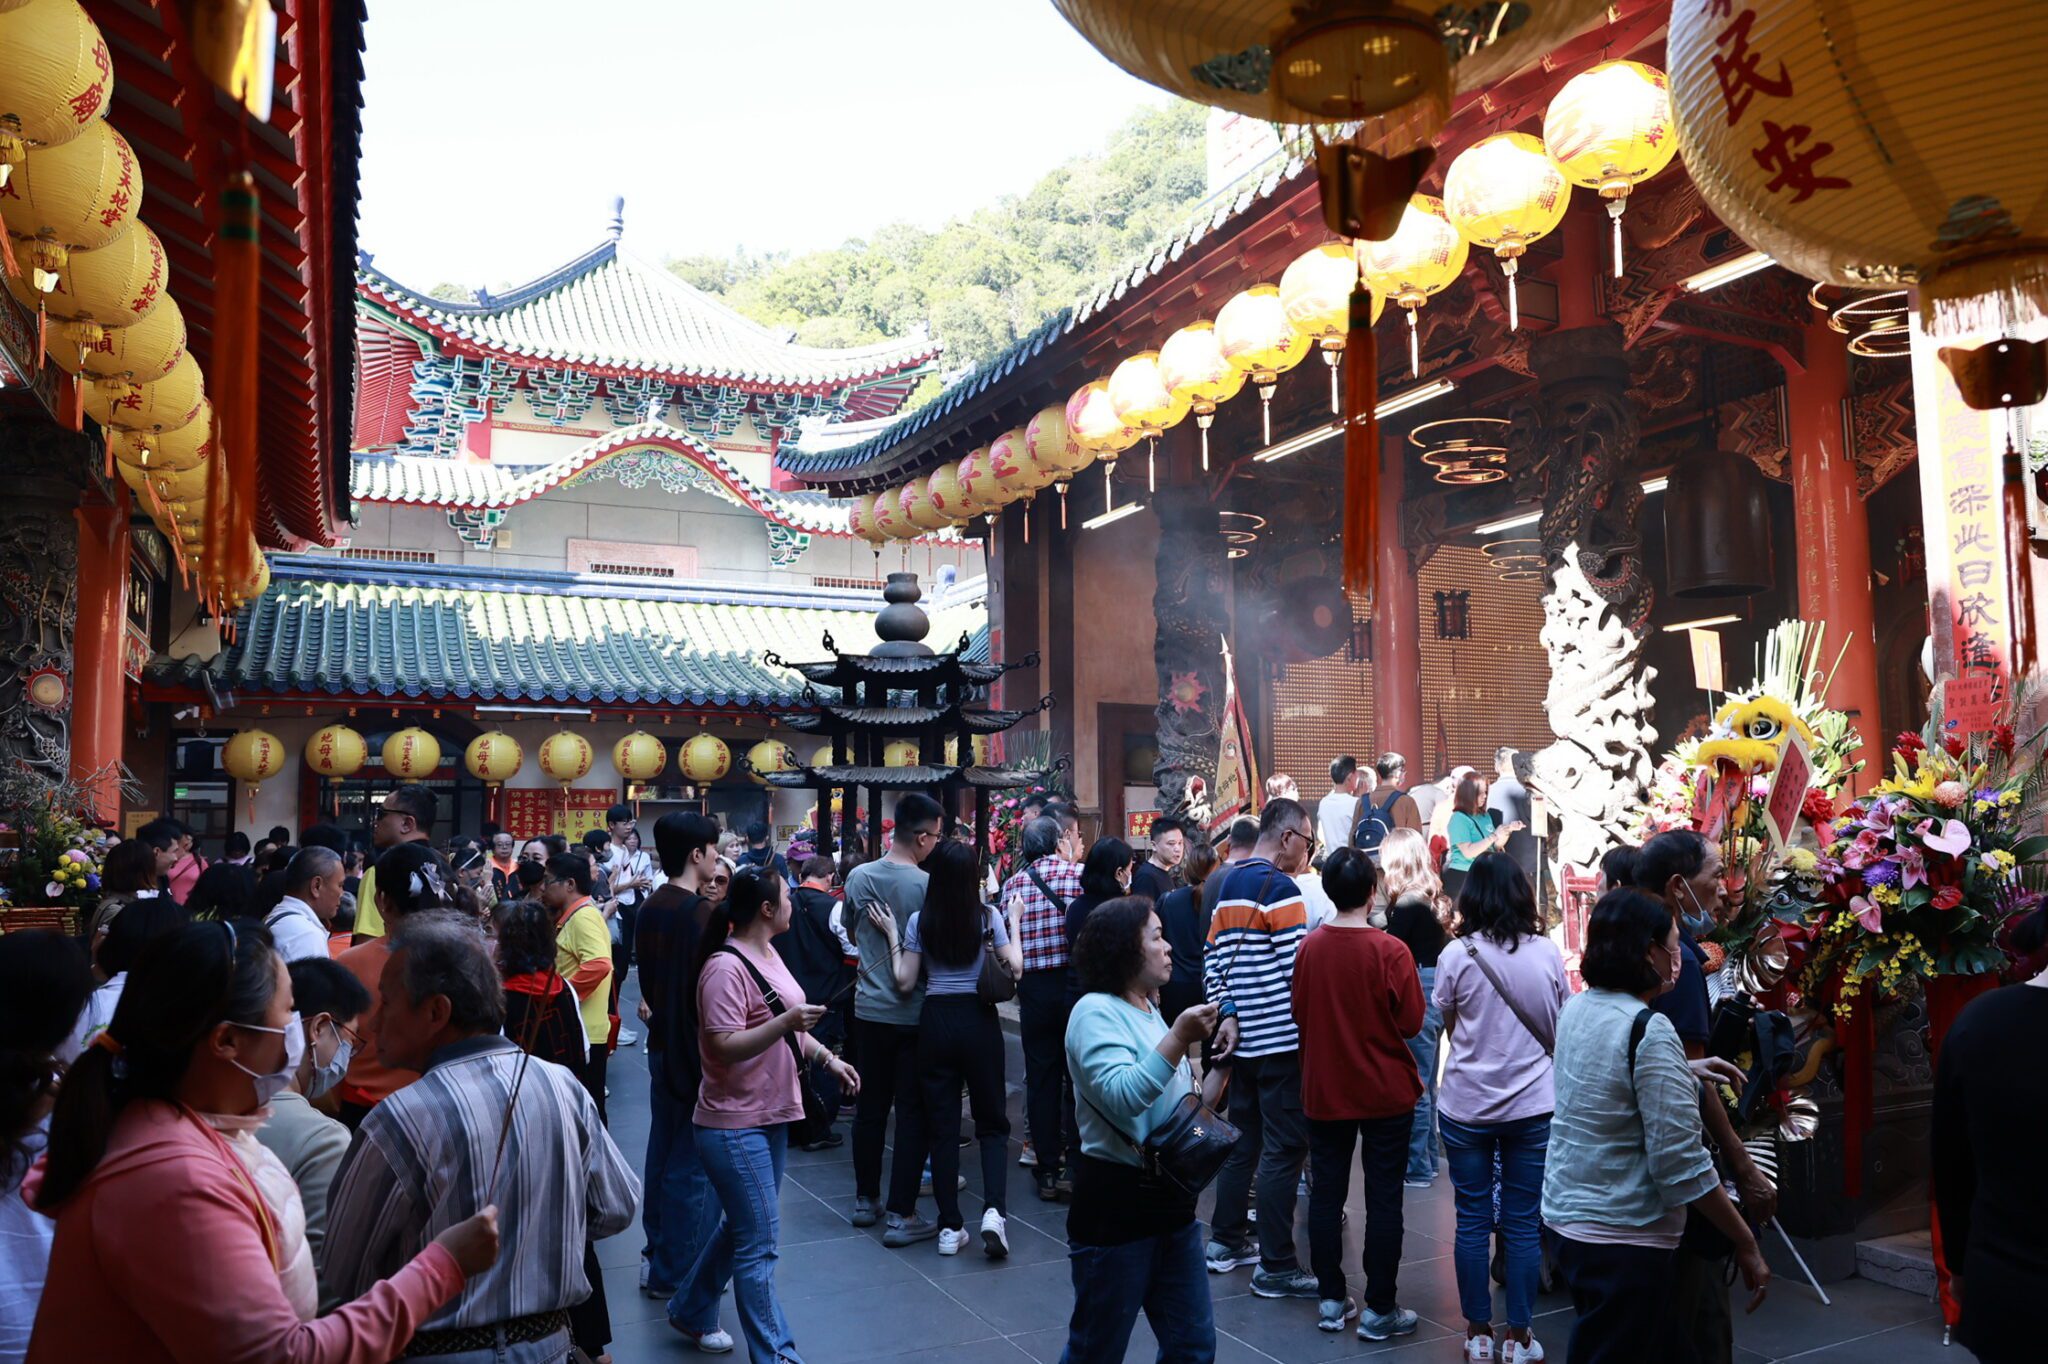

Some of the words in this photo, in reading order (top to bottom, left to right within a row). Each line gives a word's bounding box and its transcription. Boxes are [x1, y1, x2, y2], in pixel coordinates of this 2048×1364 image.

[1701, 0, 1853, 204] 民安
[319, 732, 333, 770] 地母廟
[477, 739, 491, 776] 地母廟
[714, 741, 727, 776] 地母廟
